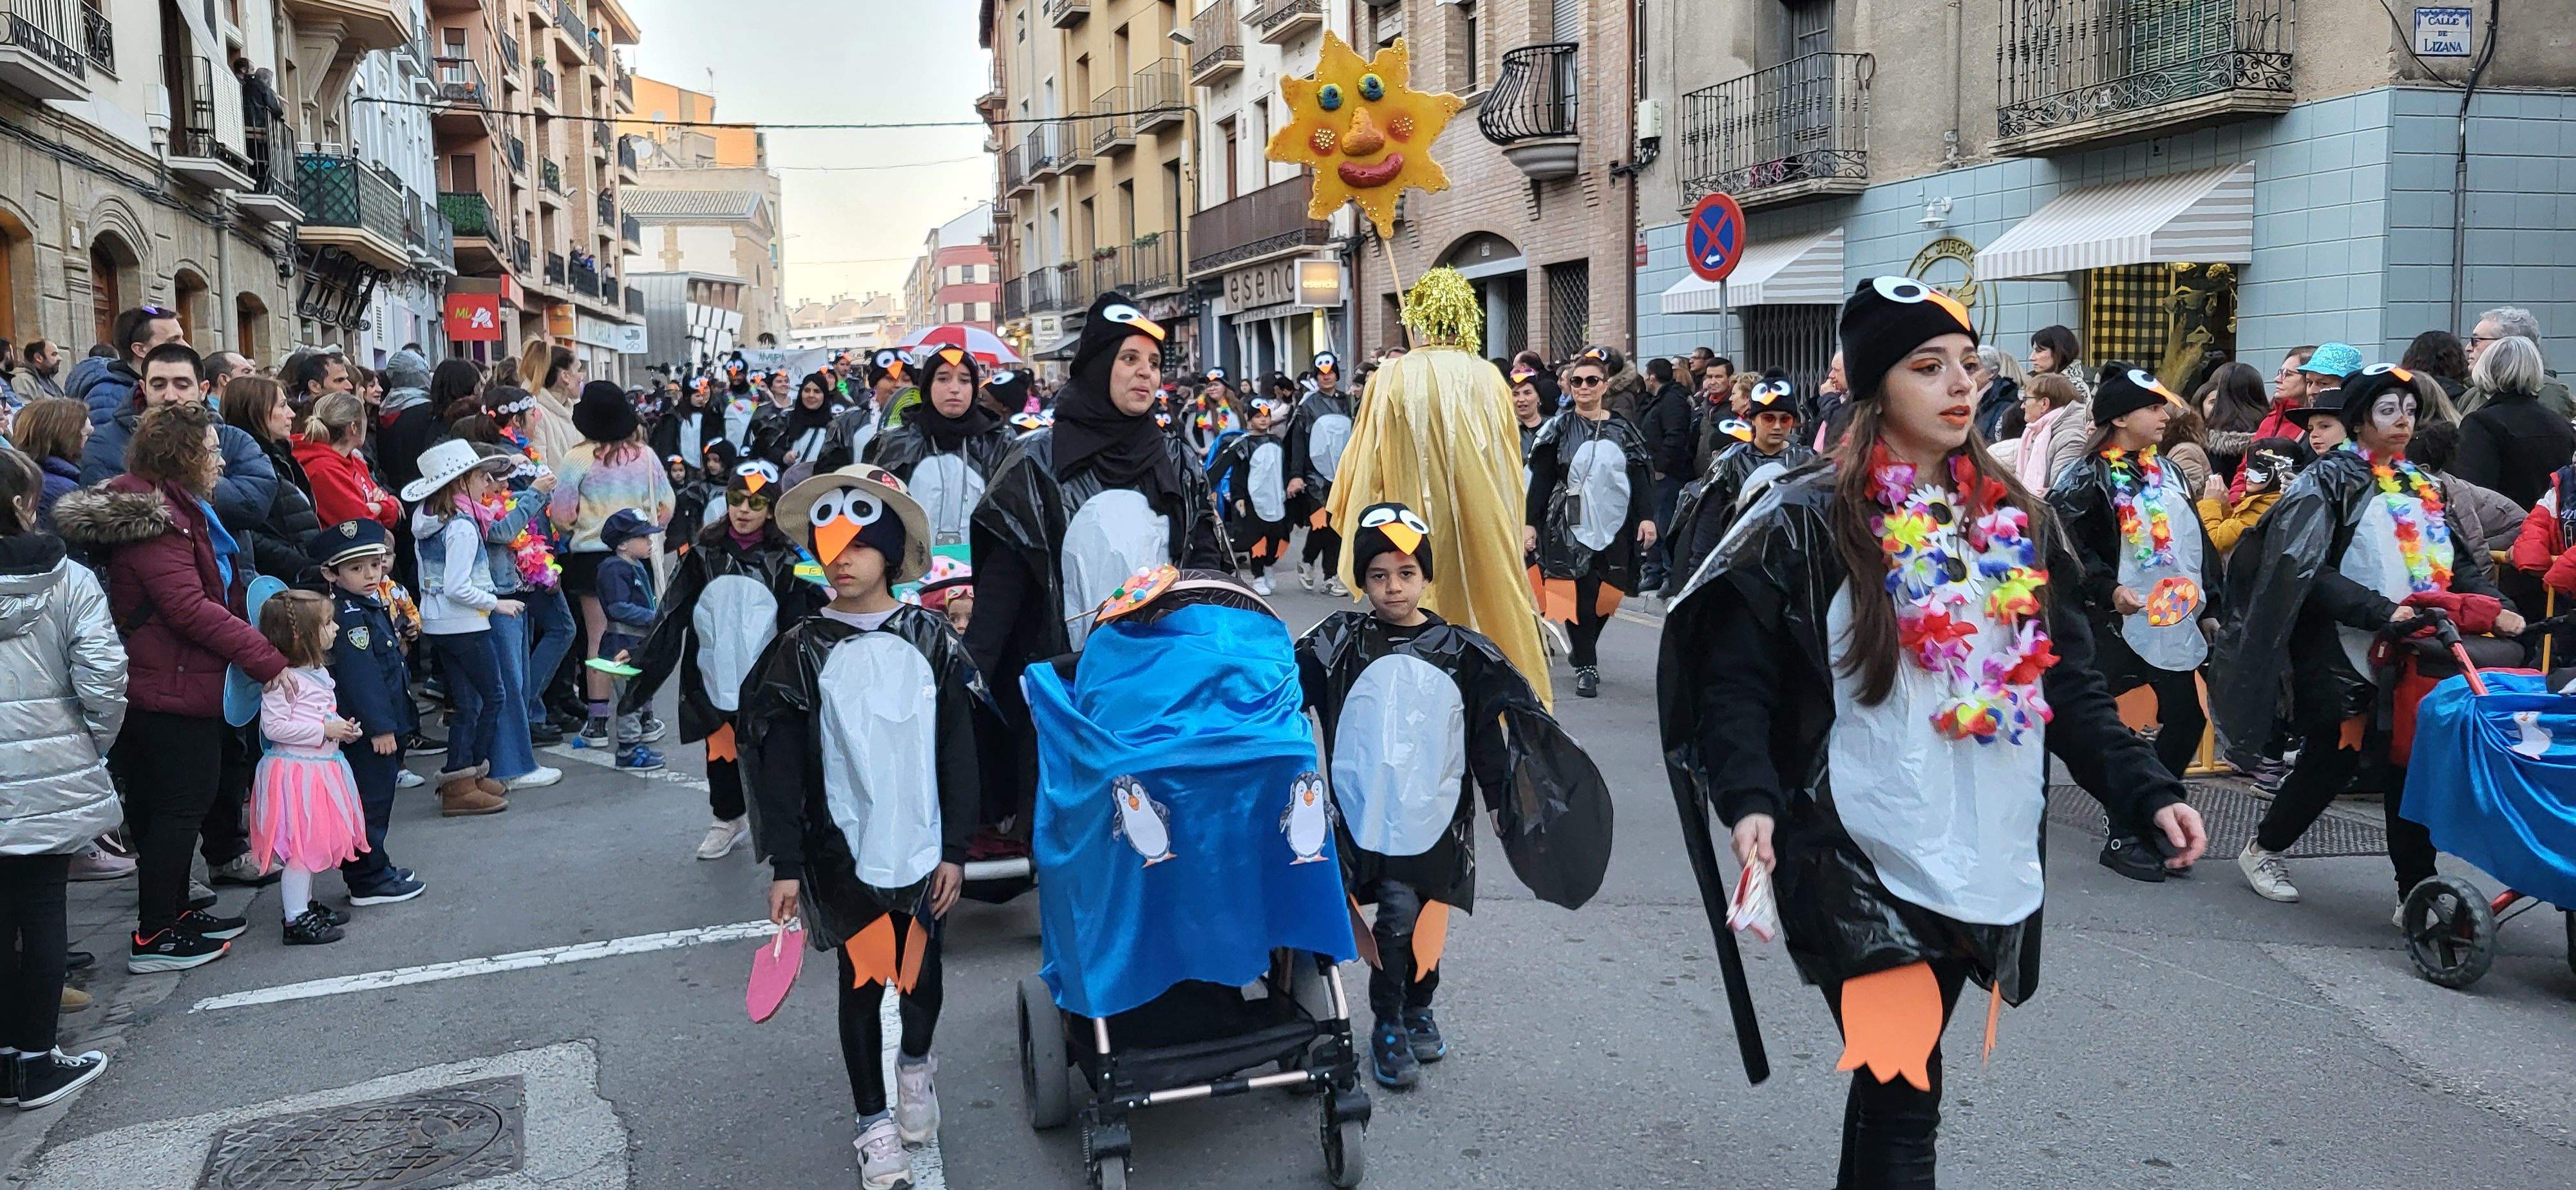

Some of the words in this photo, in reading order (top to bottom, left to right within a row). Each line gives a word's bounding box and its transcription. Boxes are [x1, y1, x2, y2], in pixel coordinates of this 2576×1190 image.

[2429, 17, 2459, 25] CALLE
[2424, 39, 2463, 52] LIZANA
[1935, 240, 1974, 263] SUEGR
[1302, 279, 1338, 288] esencia
